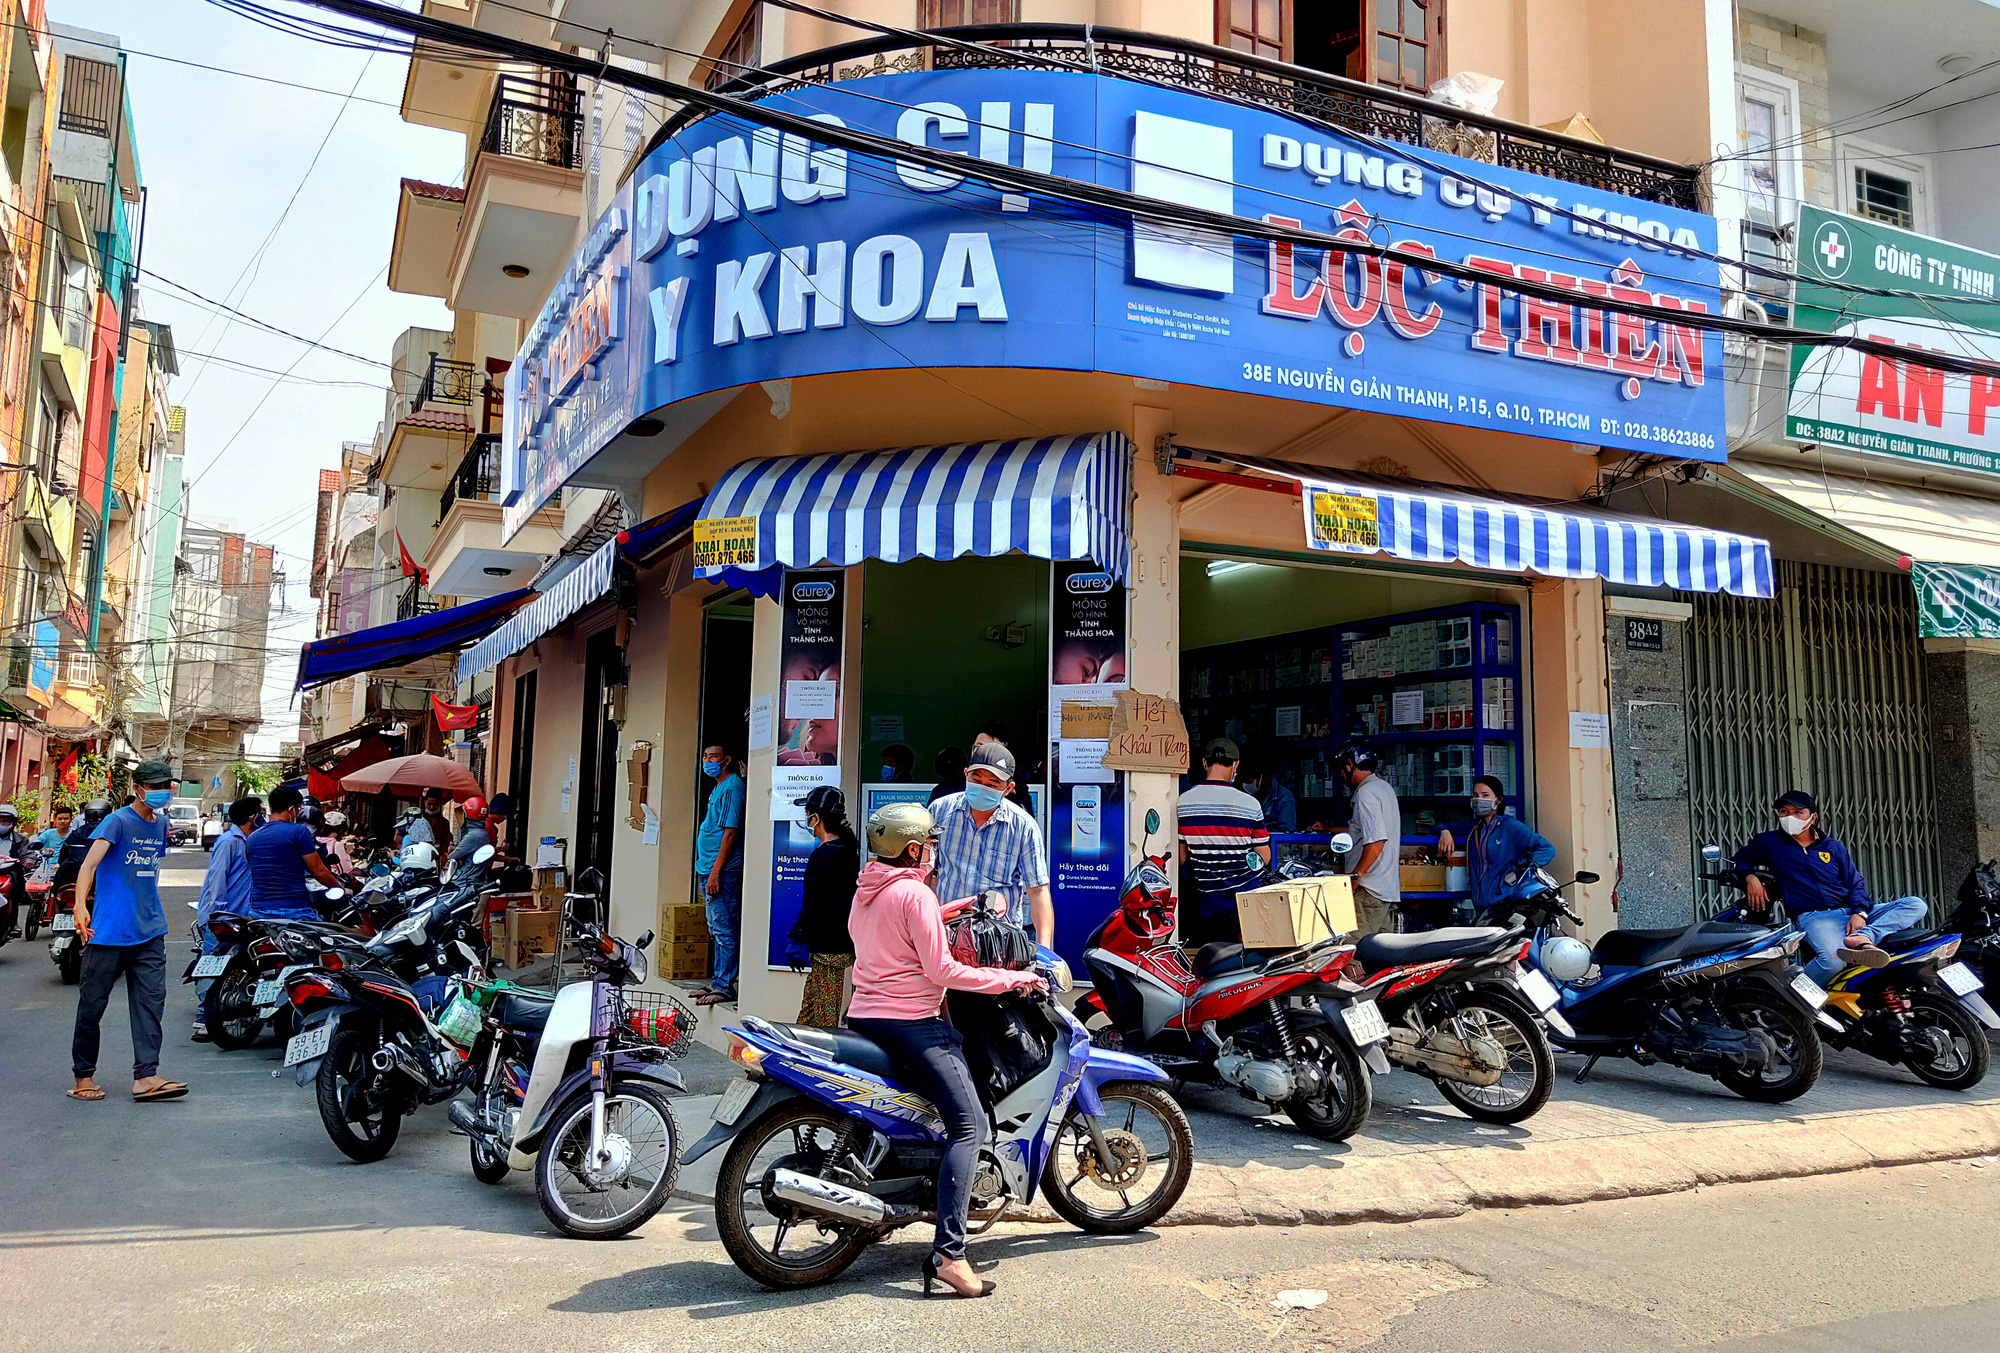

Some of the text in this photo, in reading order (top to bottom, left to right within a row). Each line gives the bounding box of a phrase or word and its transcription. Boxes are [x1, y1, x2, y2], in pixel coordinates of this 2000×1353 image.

[635, 101, 1054, 262] DỤNG CỤ
[1263, 133, 1701, 260] DỤNG CỤ Y KHOA
[1828, 244, 1838, 255] AP
[1874, 243, 1995, 298] CÔNG TY TNHH
[647, 232, 1009, 366] Y KHOA
[1262, 198, 1707, 403] LỘC THIỆN
[1172, 309, 1193, 320] Diabetes
[1856, 334, 1945, 428] AN
[1242, 362, 1715, 450] 38E NGUYỄN GIẢN THANH, P.15, Q.10, TP.HCM ĐT: 028.38623886
[1795, 422, 1814, 438] ĐC:
[1817, 426, 1844, 443] 38A2
[1848, 432, 1887, 450] NGUYỄN
[1890, 438, 1914, 455] GIẢN
[1916, 444, 1951, 462] THANH,
[1953, 451, 1992, 469] PHƯỜNG
[1315, 510, 1375, 532] KHẢI HOÀN
[695, 534, 755, 554] KHẢI HOÀN
[1316, 527, 1377, 546] 0903.876.466
[695, 550, 755, 568] 0903.876.466
[1070, 575, 1108, 589] durex
[796, 585, 831, 598] durex
[797, 605, 829, 616] MỎNG
[1072, 597, 1107, 609] MỎNG
[1071, 610, 1084, 618] VÔ
[1080, 619, 1099, 627] TÌNH
[803, 626, 821, 634] TÌNH
[1065, 629, 1114, 637] THĂNG HOA
[1629, 621, 1659, 639] 38A2
[1133, 697, 1169, 724] Hết
[1120, 724, 1152, 756] Khẩu
[1077, 800, 1096, 808] durex
[125, 850, 151, 865] Pure
[777, 856, 791, 864] Hãy
[1059, 863, 1110, 872] Hãy theo dõi
[294, 1029, 323, 1049] 59-E1
[287, 1041, 326, 1064] 336.37
